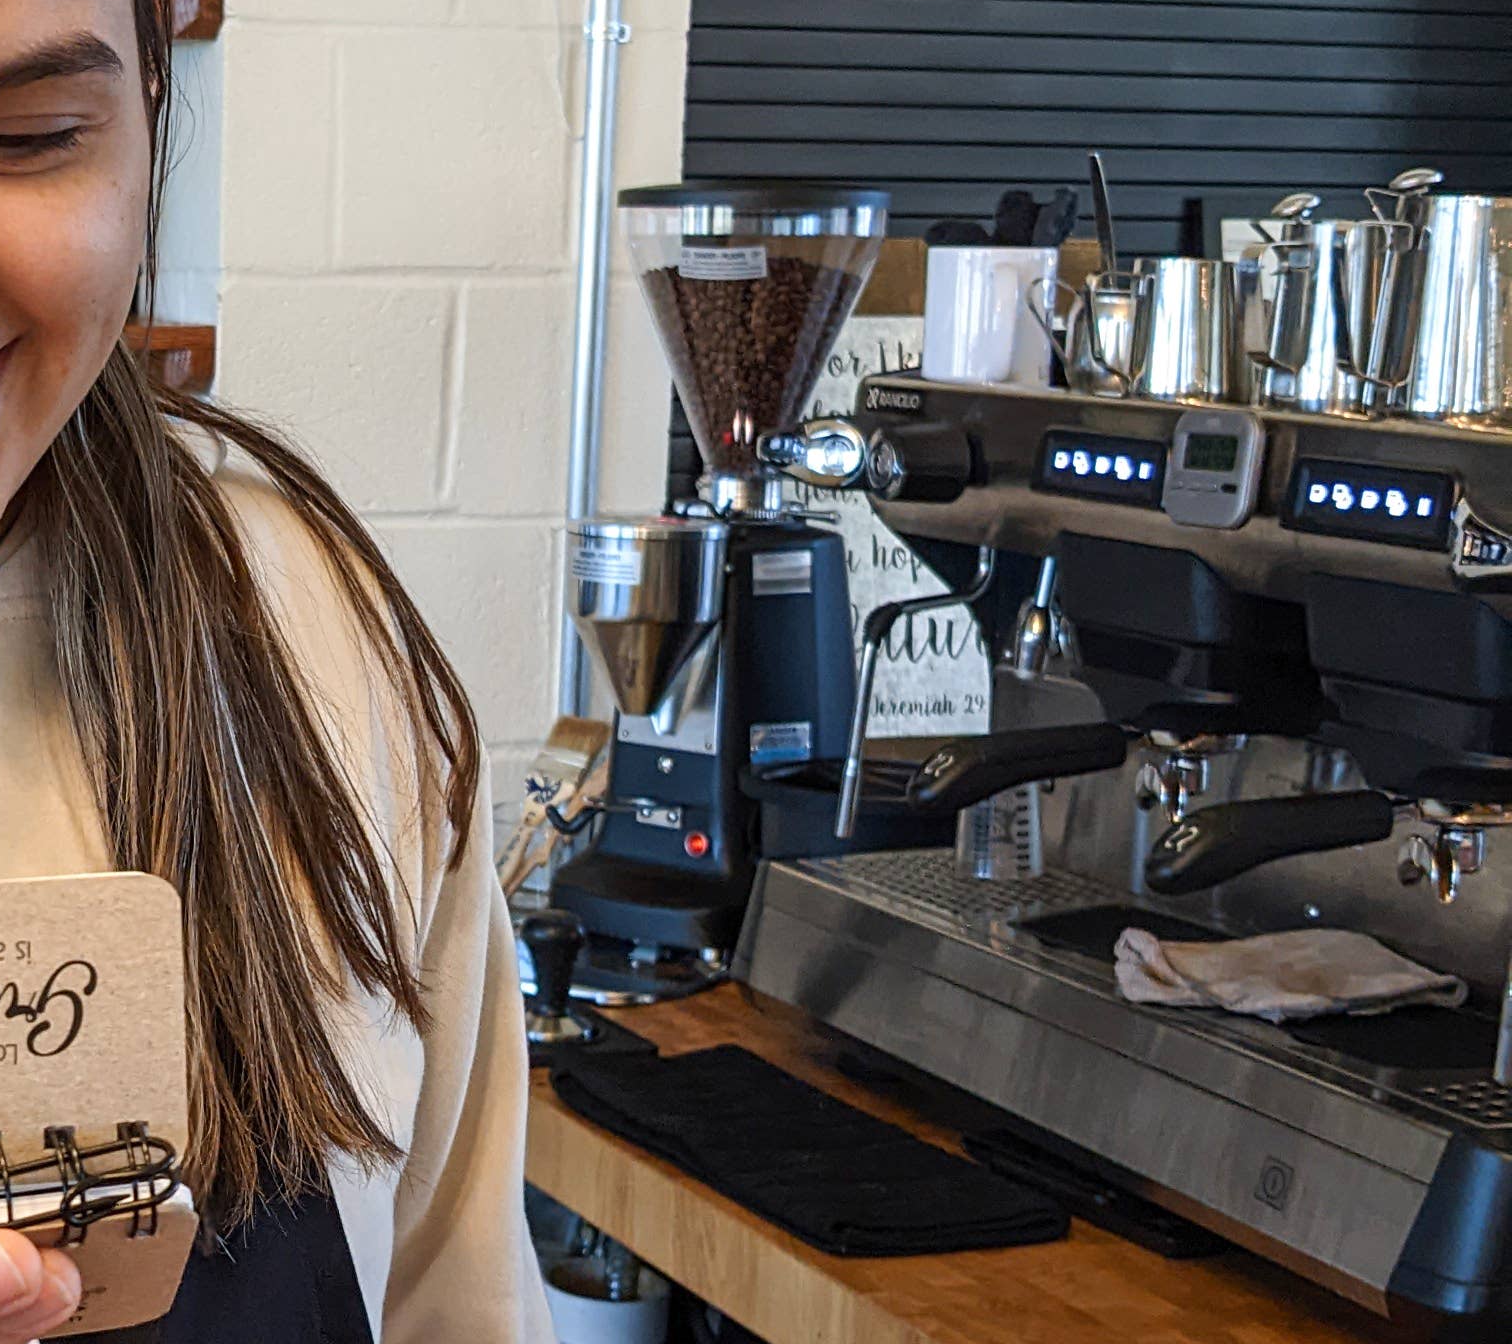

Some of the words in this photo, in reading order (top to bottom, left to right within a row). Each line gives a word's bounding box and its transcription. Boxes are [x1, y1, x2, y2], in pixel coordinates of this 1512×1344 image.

[871, 532, 923, 584] hop
[871, 693, 955, 718] Jeremiah
[14, 939, 33, 965] is
